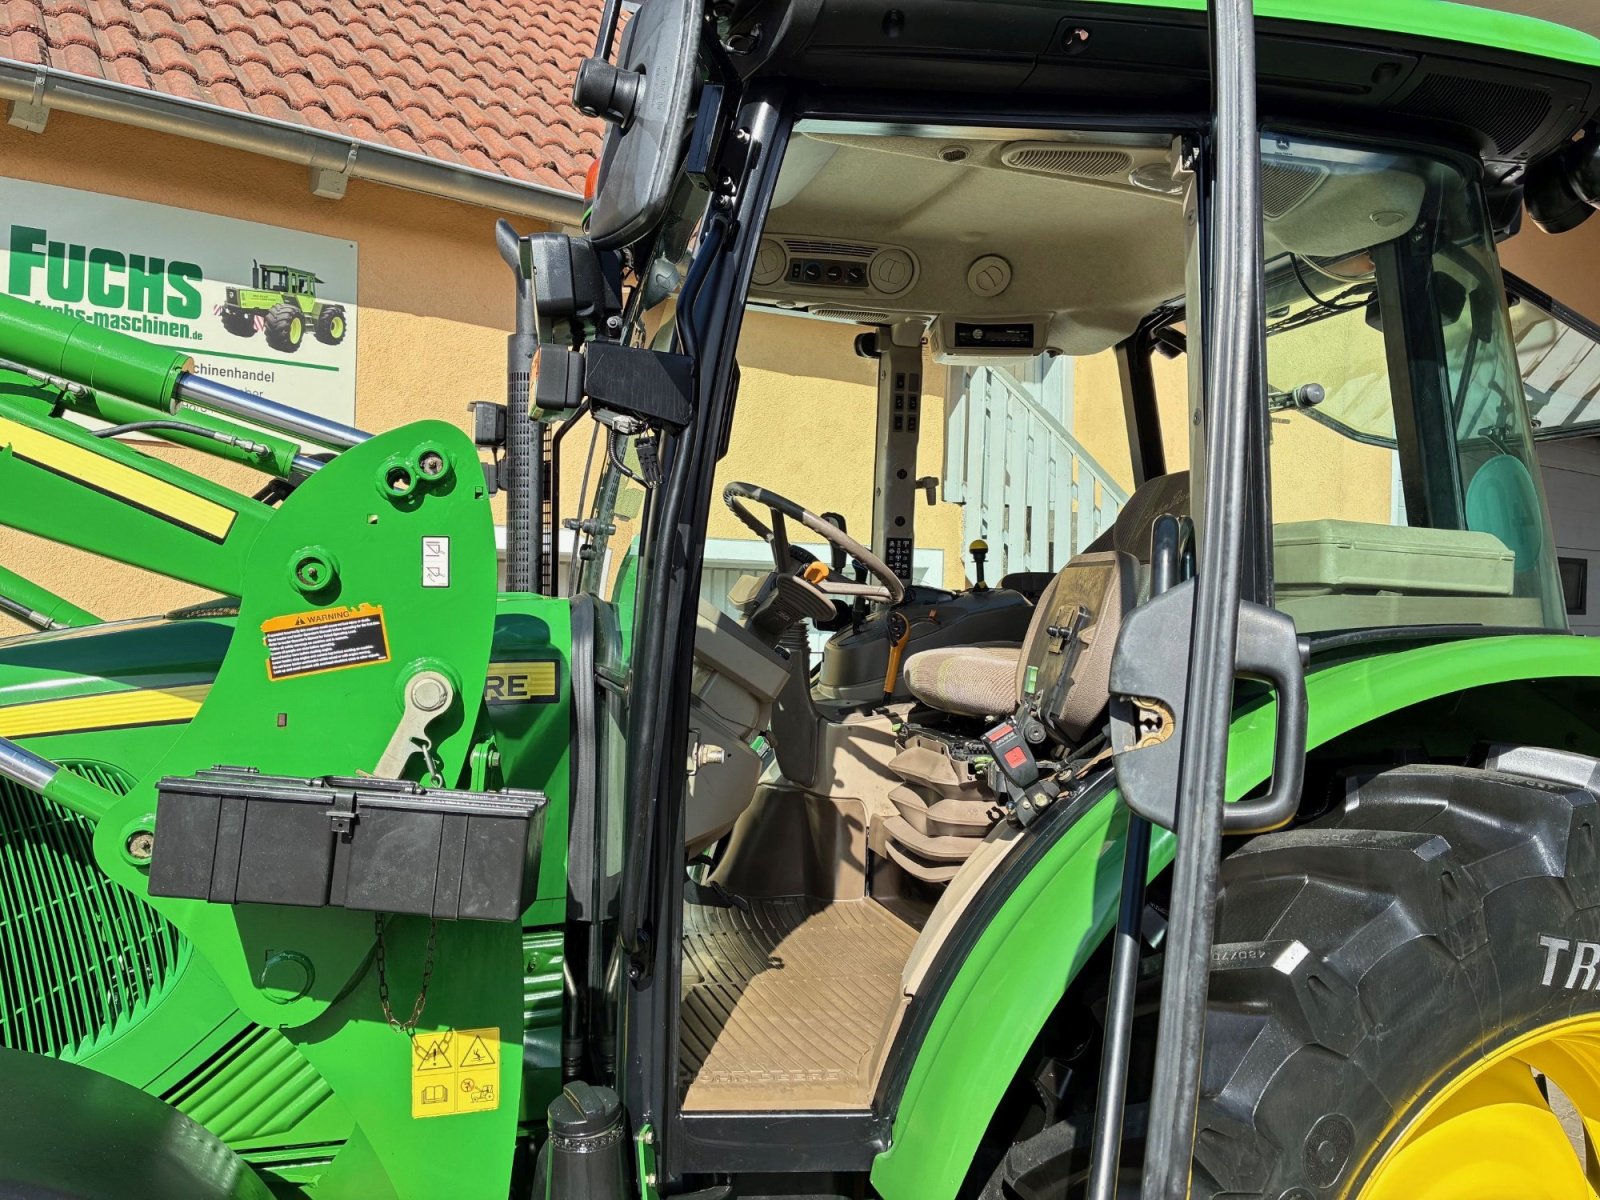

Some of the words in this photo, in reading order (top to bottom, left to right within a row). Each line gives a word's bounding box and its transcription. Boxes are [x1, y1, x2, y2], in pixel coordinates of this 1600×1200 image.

[8, 224, 203, 320] FUCHS
[193, 363, 275, 383] chinenhandel
[307, 611, 350, 625] WARNING
[1539, 935, 1600, 990] TR
